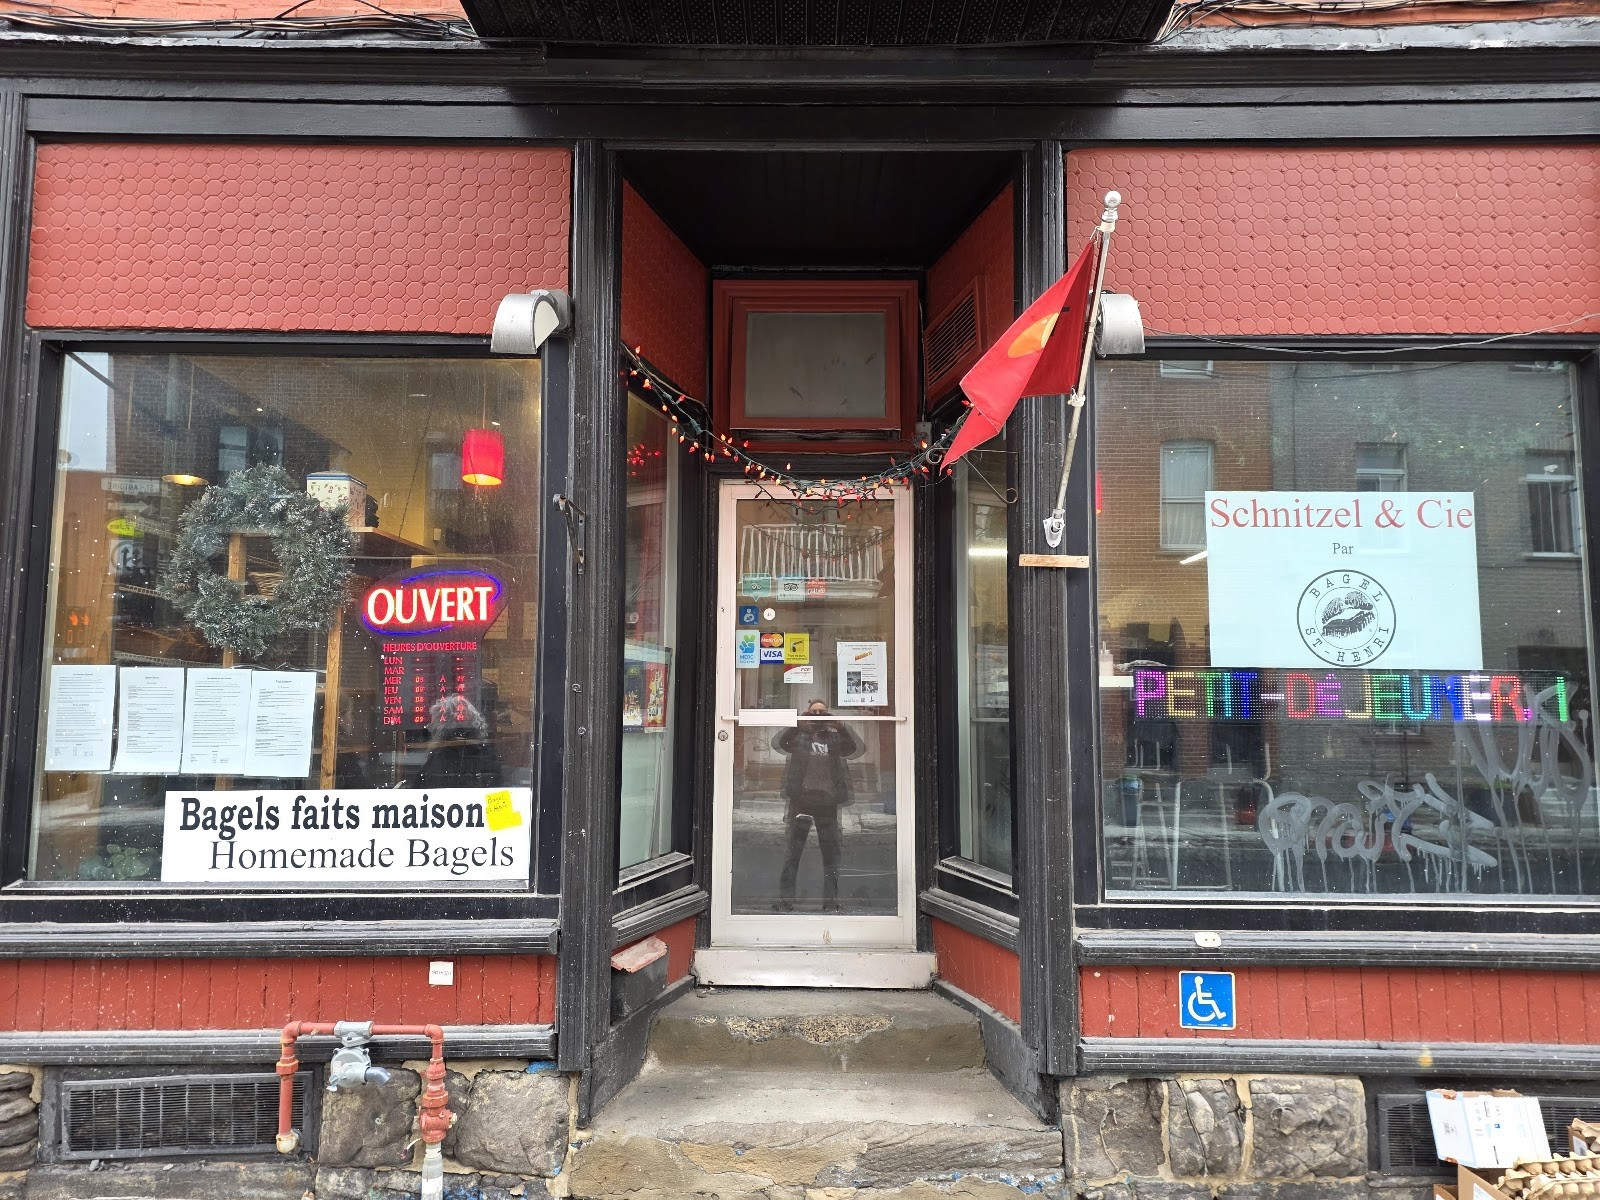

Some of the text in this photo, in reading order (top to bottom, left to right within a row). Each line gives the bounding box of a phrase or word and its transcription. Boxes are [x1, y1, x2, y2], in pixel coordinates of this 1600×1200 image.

[1210, 498, 1473, 528] Schnitzel & Cie
[1332, 542, 1354, 555] Par
[1309, 573, 1382, 602] BAGEL
[367, 587, 492, 625] OUVERT
[383, 642, 477, 652] HEURES D'OUVERTURE
[384, 657, 403, 665] LUN
[384, 667, 404, 675] MAR
[384, 706, 403, 715] SAM
[384, 716, 401, 724] DIM
[180, 794, 485, 840] Bagels faits maison
[208, 837, 514, 875] Homemade Bagels
